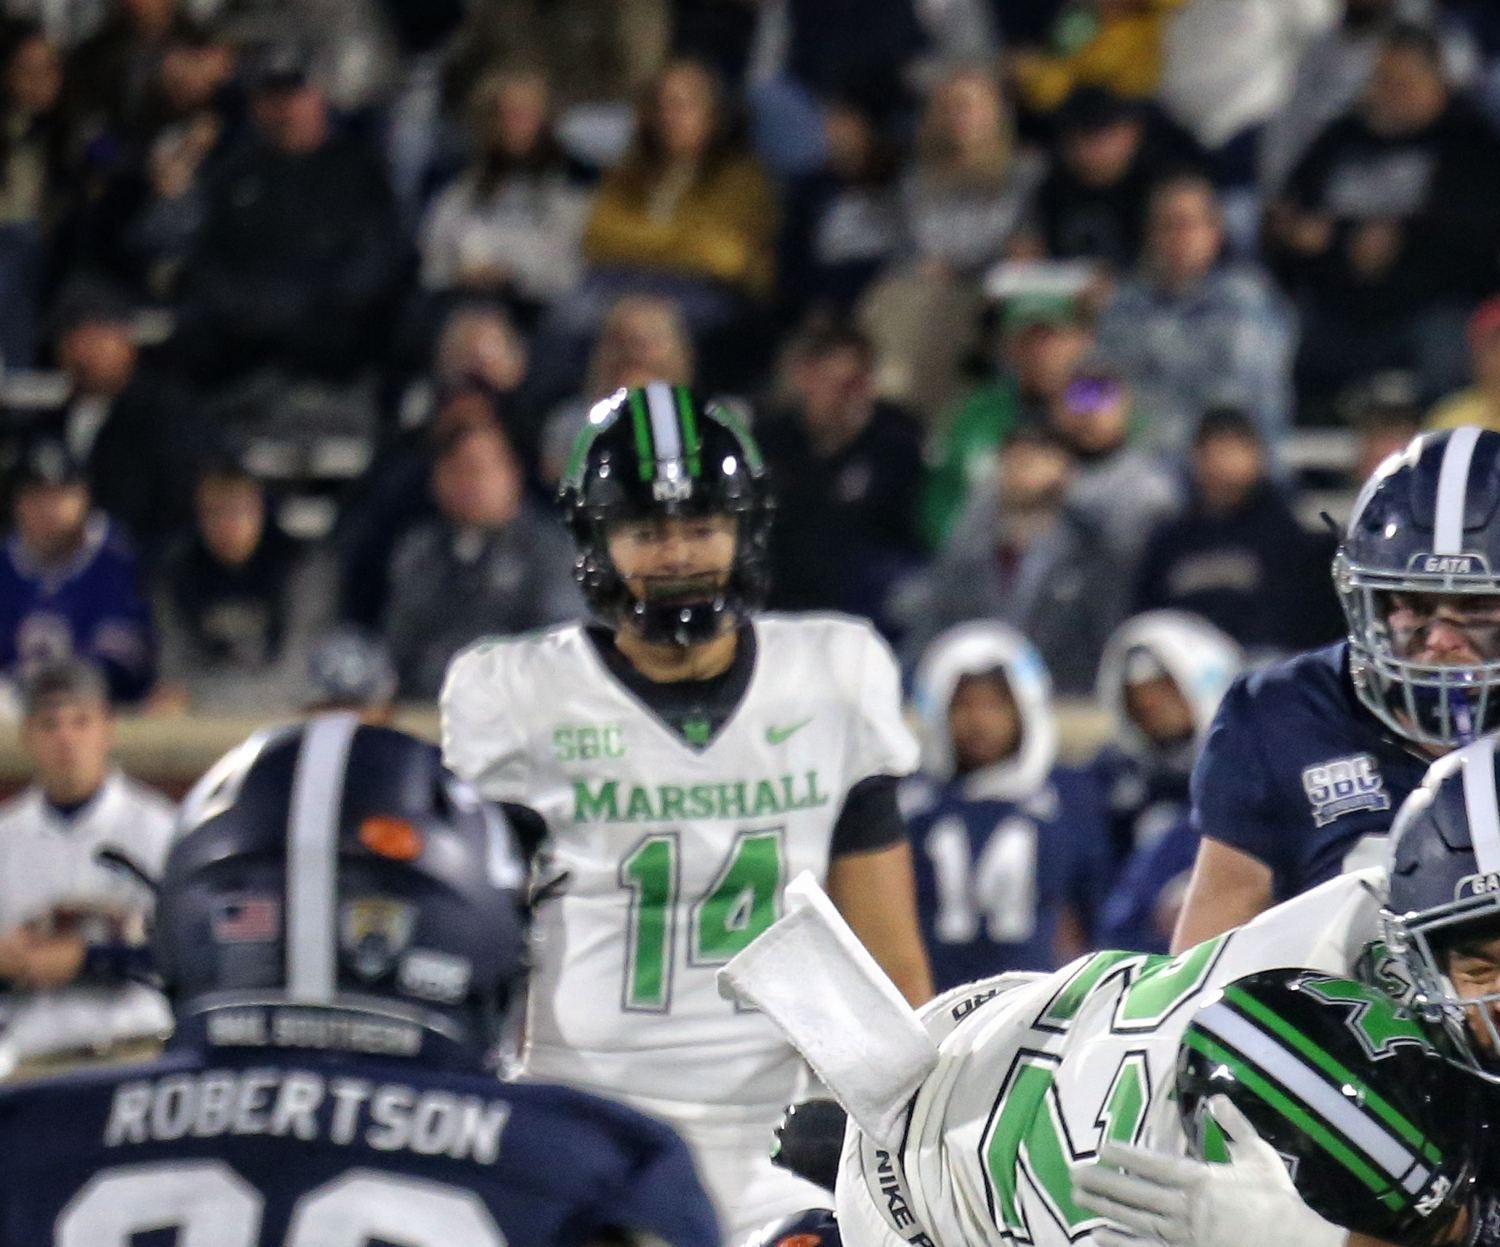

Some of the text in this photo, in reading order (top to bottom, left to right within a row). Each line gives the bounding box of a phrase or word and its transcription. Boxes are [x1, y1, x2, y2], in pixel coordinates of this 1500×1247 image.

[1424, 557, 1471, 574] GATA
[553, 721, 626, 763] SBC
[571, 768, 831, 824] MARSHALL
[1302, 754, 1383, 806] SBC
[926, 812, 1040, 944] 14
[617, 825, 788, 1016] 14
[105, 1068, 511, 1164] ROBERTSON
[875, 1148, 916, 1230] NIKE
